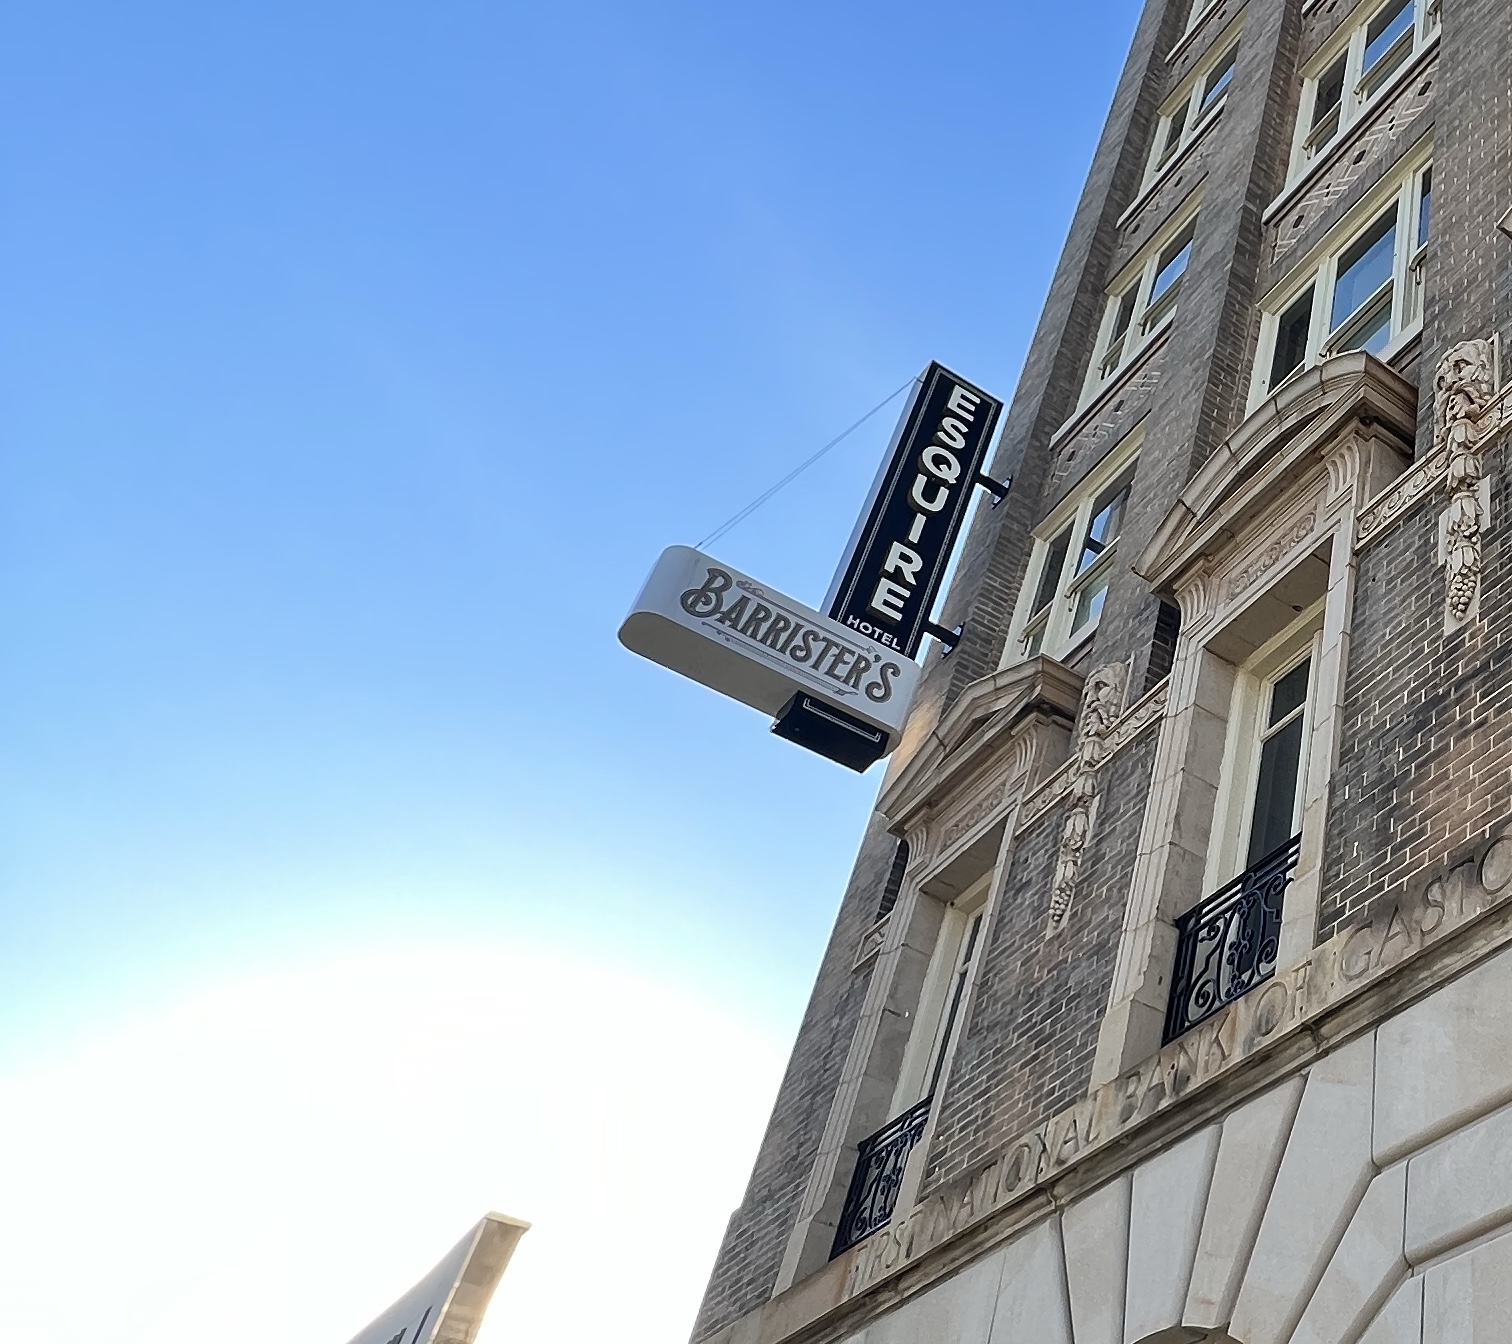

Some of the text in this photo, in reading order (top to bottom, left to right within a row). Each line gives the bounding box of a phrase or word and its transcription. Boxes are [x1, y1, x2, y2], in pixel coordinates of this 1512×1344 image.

[870, 385, 981, 622] ESQUIRE
[679, 567, 901, 703] BARRISTER'S
[846, 614, 901, 650] HOTEL
[850, 1208, 924, 1298] FIRST
[929, 1090, 1102, 1244] NATIONAL
[1117, 1008, 1233, 1126] BANK
[1252, 959, 1313, 1038] OF
